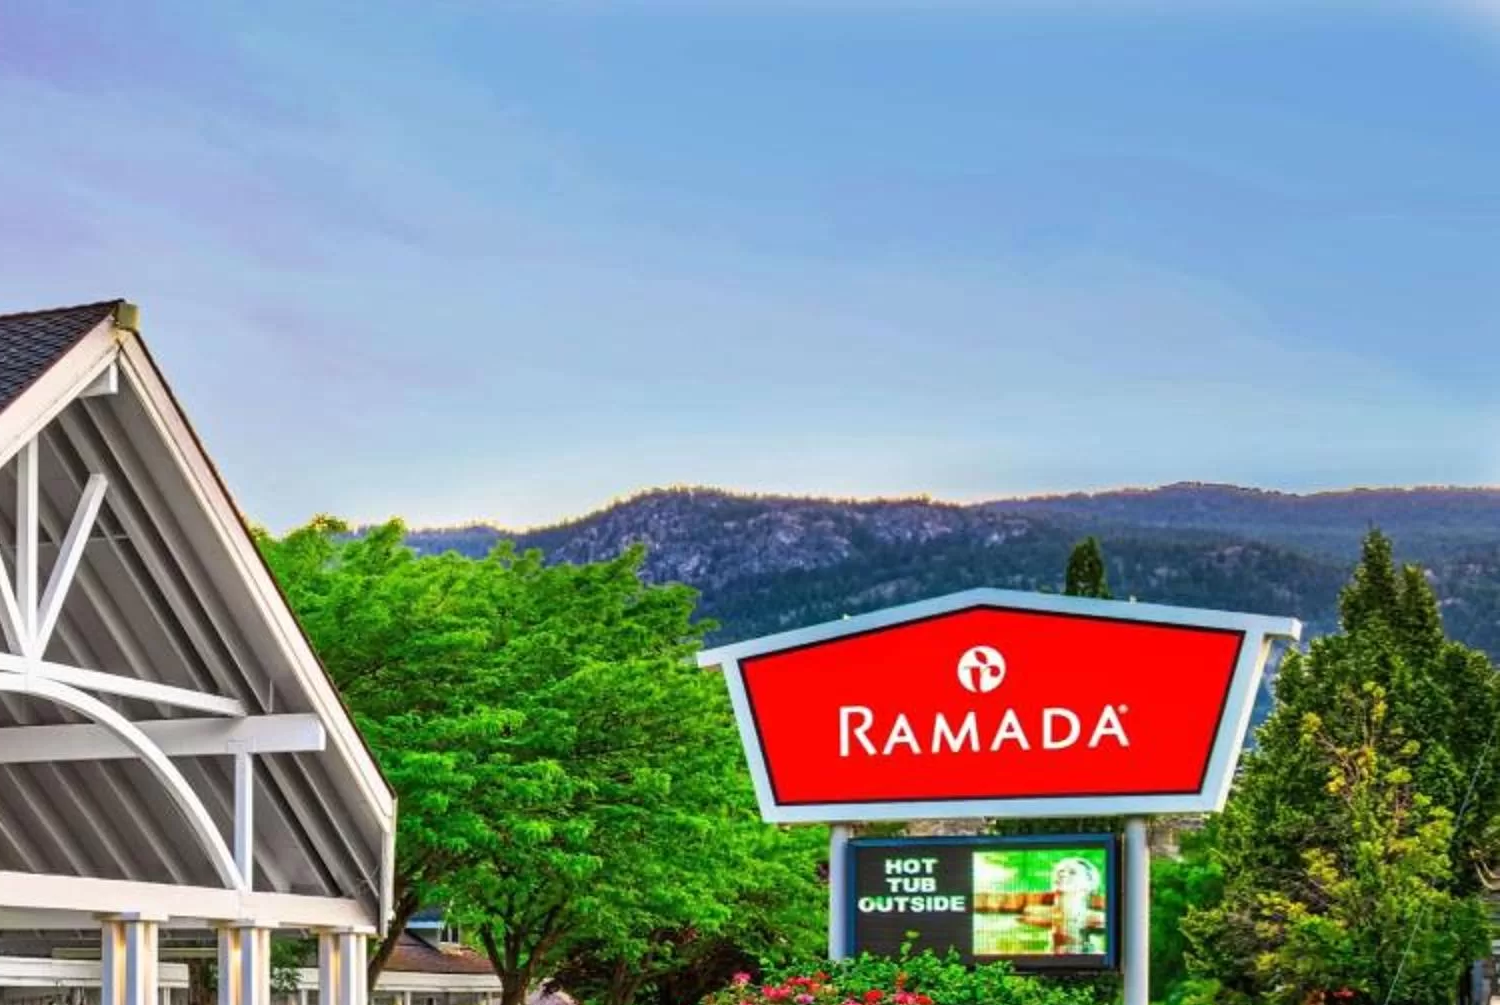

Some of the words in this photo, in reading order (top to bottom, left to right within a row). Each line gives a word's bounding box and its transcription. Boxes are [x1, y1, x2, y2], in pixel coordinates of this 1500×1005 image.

[838, 704, 1130, 757] RAMADA
[884, 857, 939, 875] HOT
[885, 877, 938, 893] TUB
[857, 895, 967, 913] OUTSIDE
